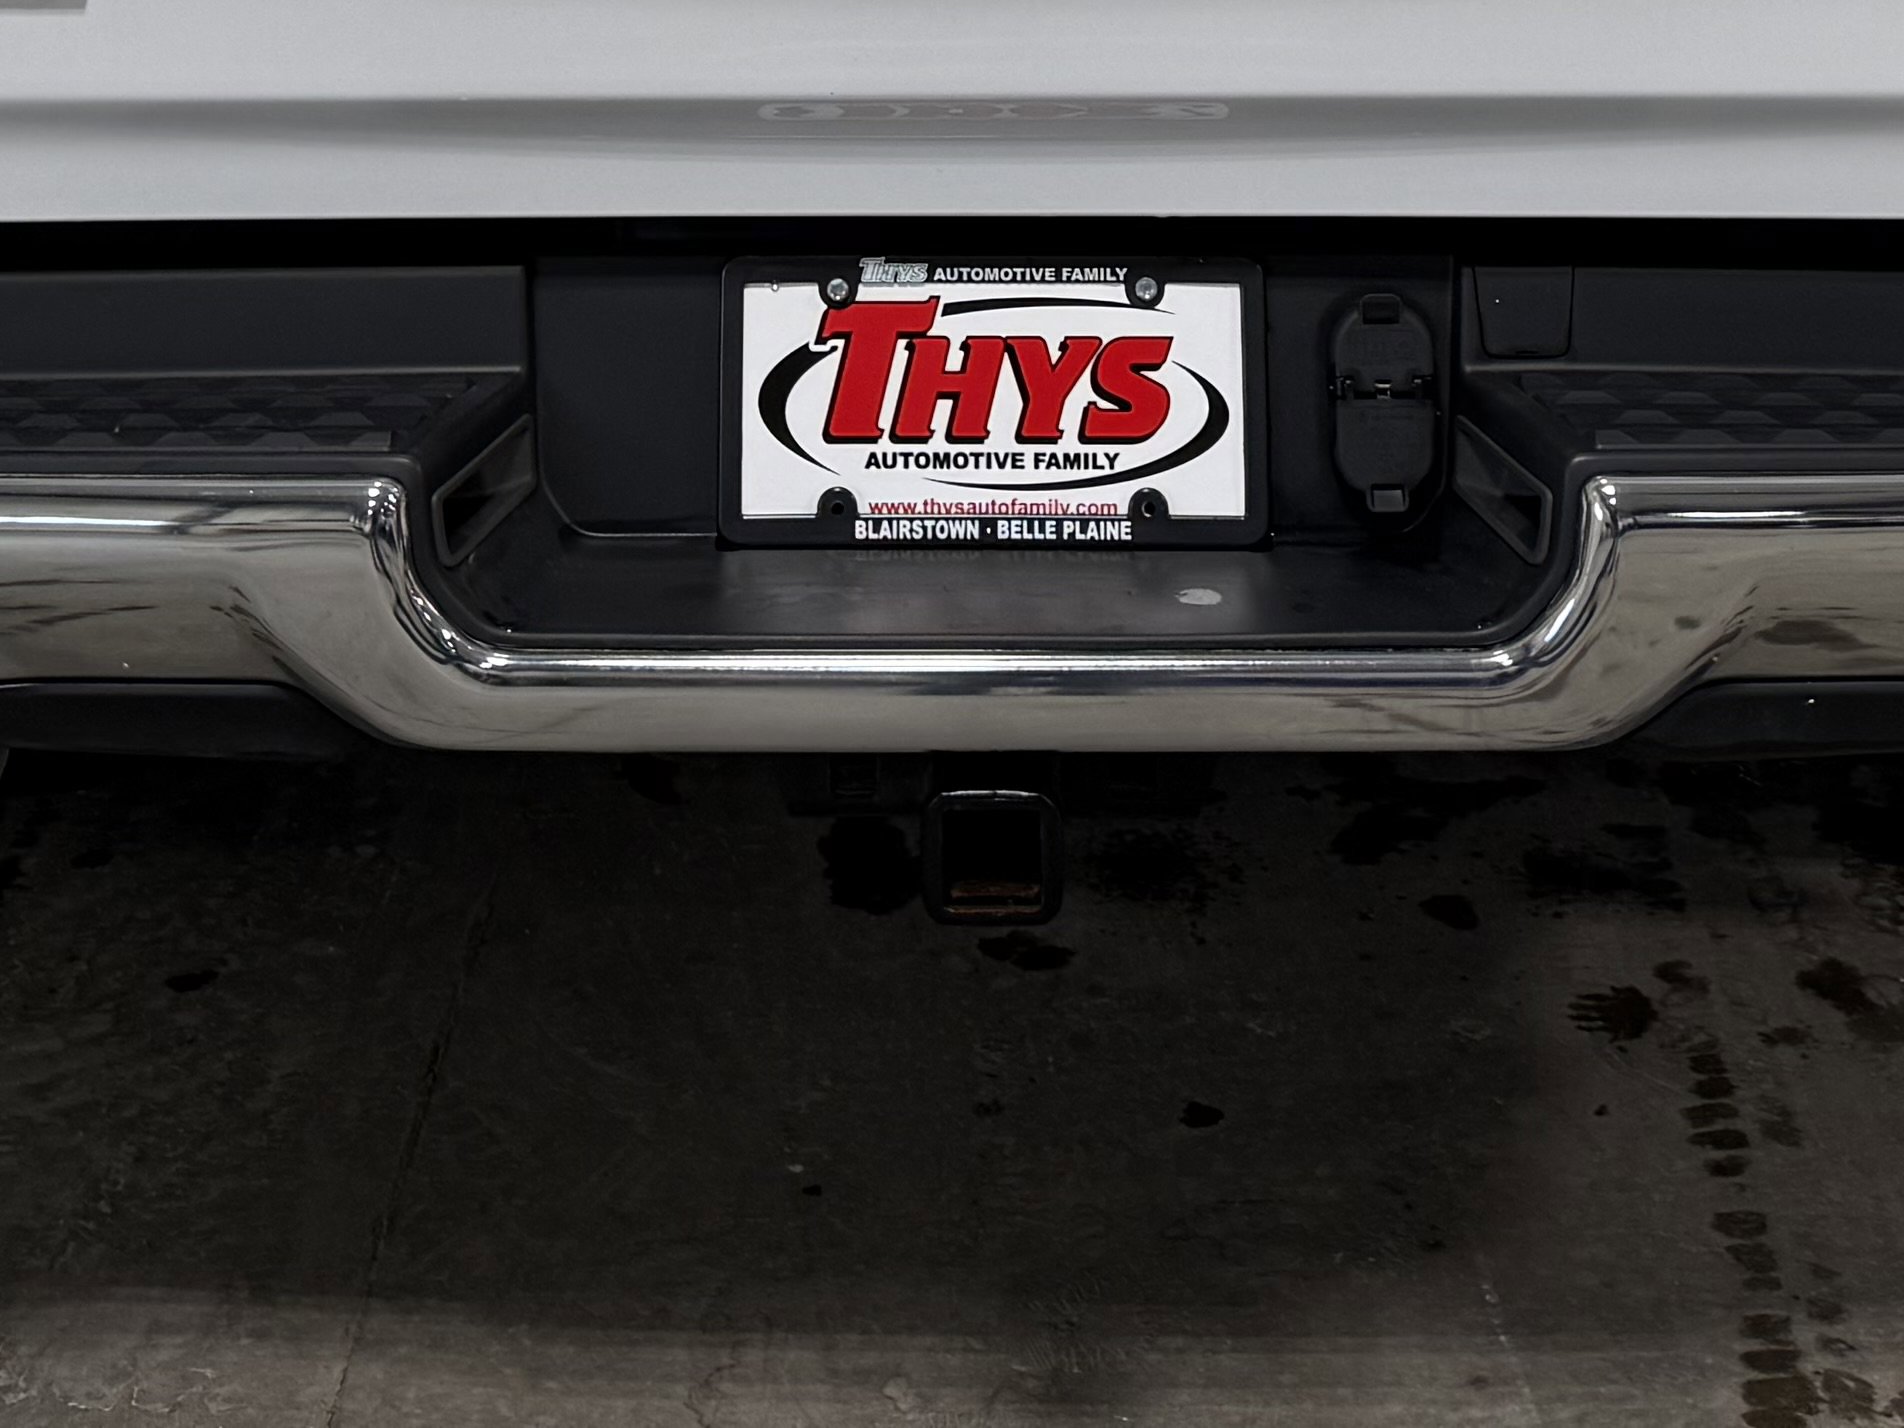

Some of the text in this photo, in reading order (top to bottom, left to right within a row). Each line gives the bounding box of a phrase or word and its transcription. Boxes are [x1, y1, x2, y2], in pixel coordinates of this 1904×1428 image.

[859, 257, 1128, 284] THYS AUTOMOTIVE FAMILY
[817, 295, 1173, 444] THYS
[864, 452, 1120, 470] AUTOMOTIVE FAMILY
[868, 498, 1118, 515] www.thysautofamily.com
[855, 519, 1132, 540] BLAIRSTOWN BELLE PLAINE
